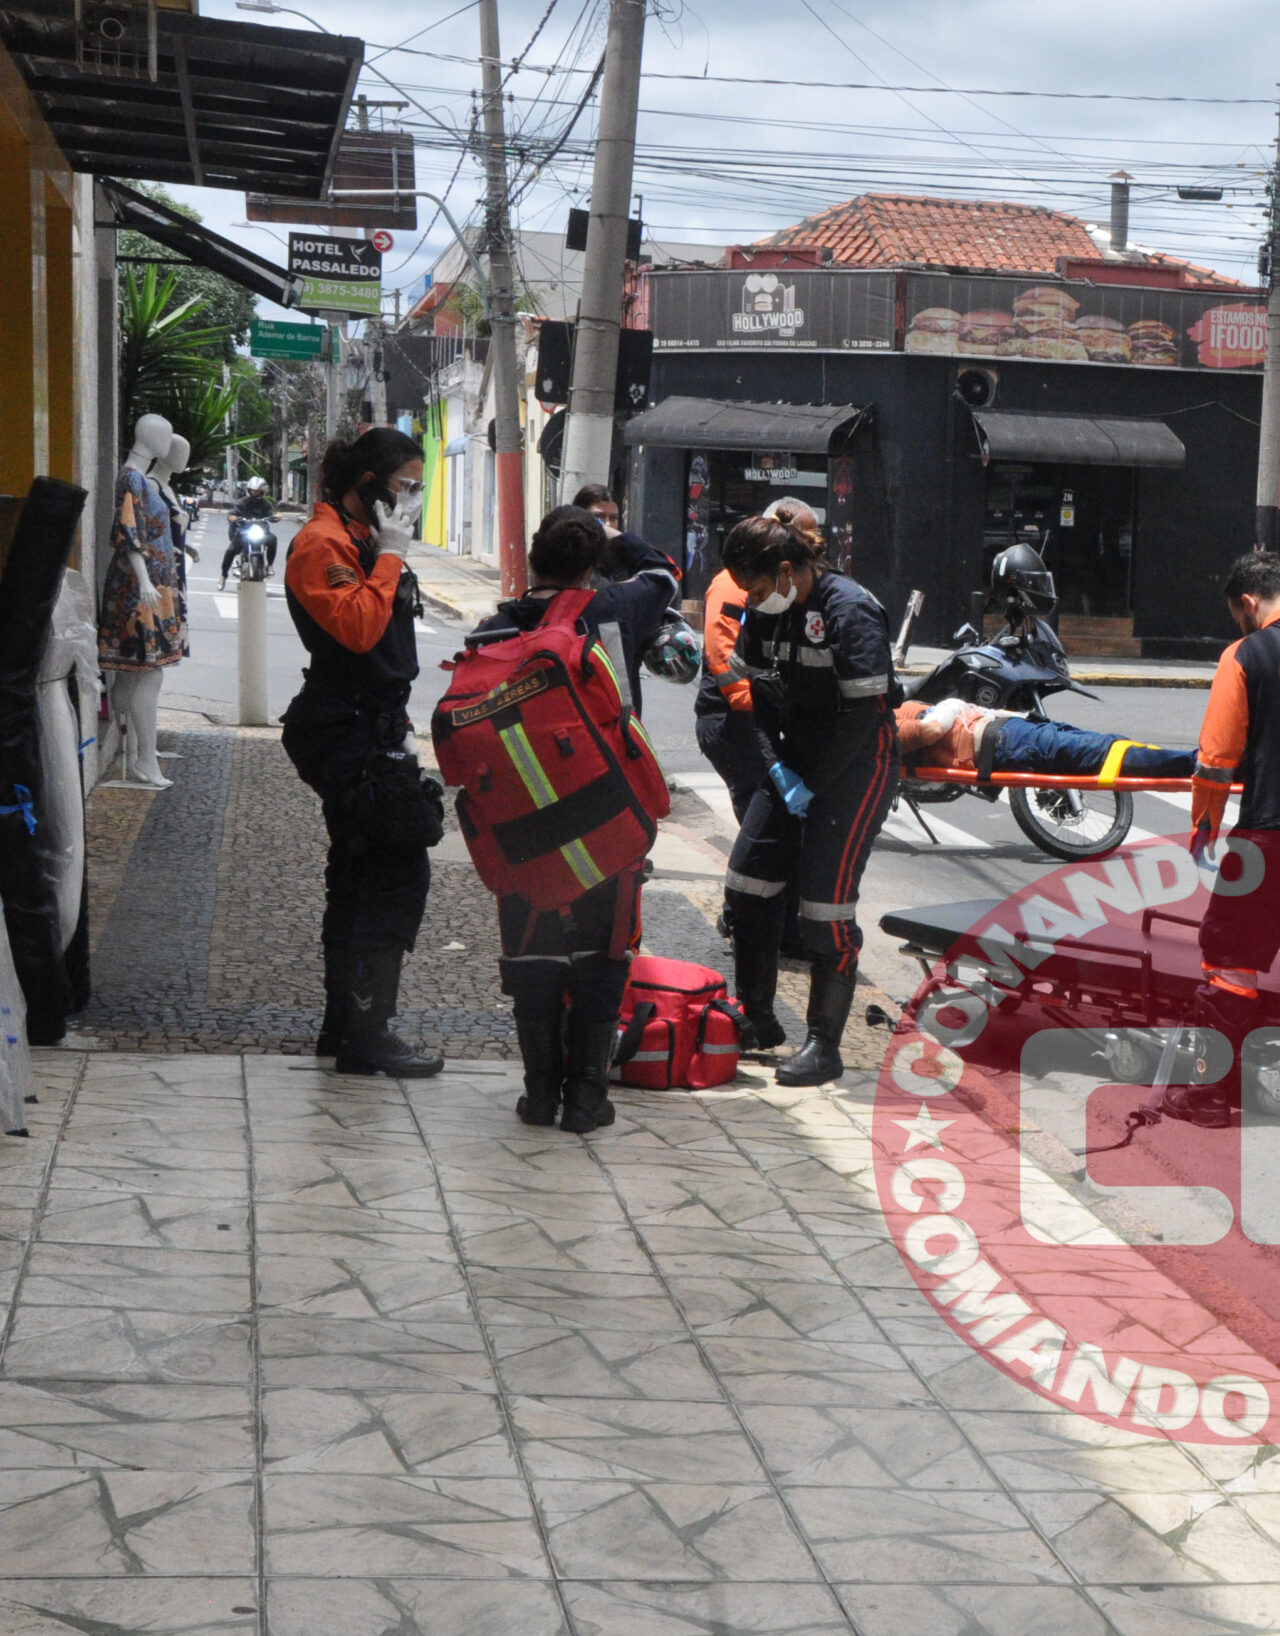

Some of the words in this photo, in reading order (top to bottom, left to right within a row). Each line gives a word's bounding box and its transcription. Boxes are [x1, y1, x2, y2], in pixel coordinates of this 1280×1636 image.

[292, 240, 343, 256] HOTEL
[292, 258, 380, 277] PASSALEDO
[318, 282, 379, 299] 3875-3480
[257, 320, 275, 330] Rua
[733, 310, 803, 331] HOLLYWOOD
[1210, 310, 1255, 325] ESTAMOS
[286, 333, 296, 341] de
[296, 333, 320, 343] Barros
[744, 467, 797, 481] HOLLYWOOD
[461, 703, 489, 720] VIAS
